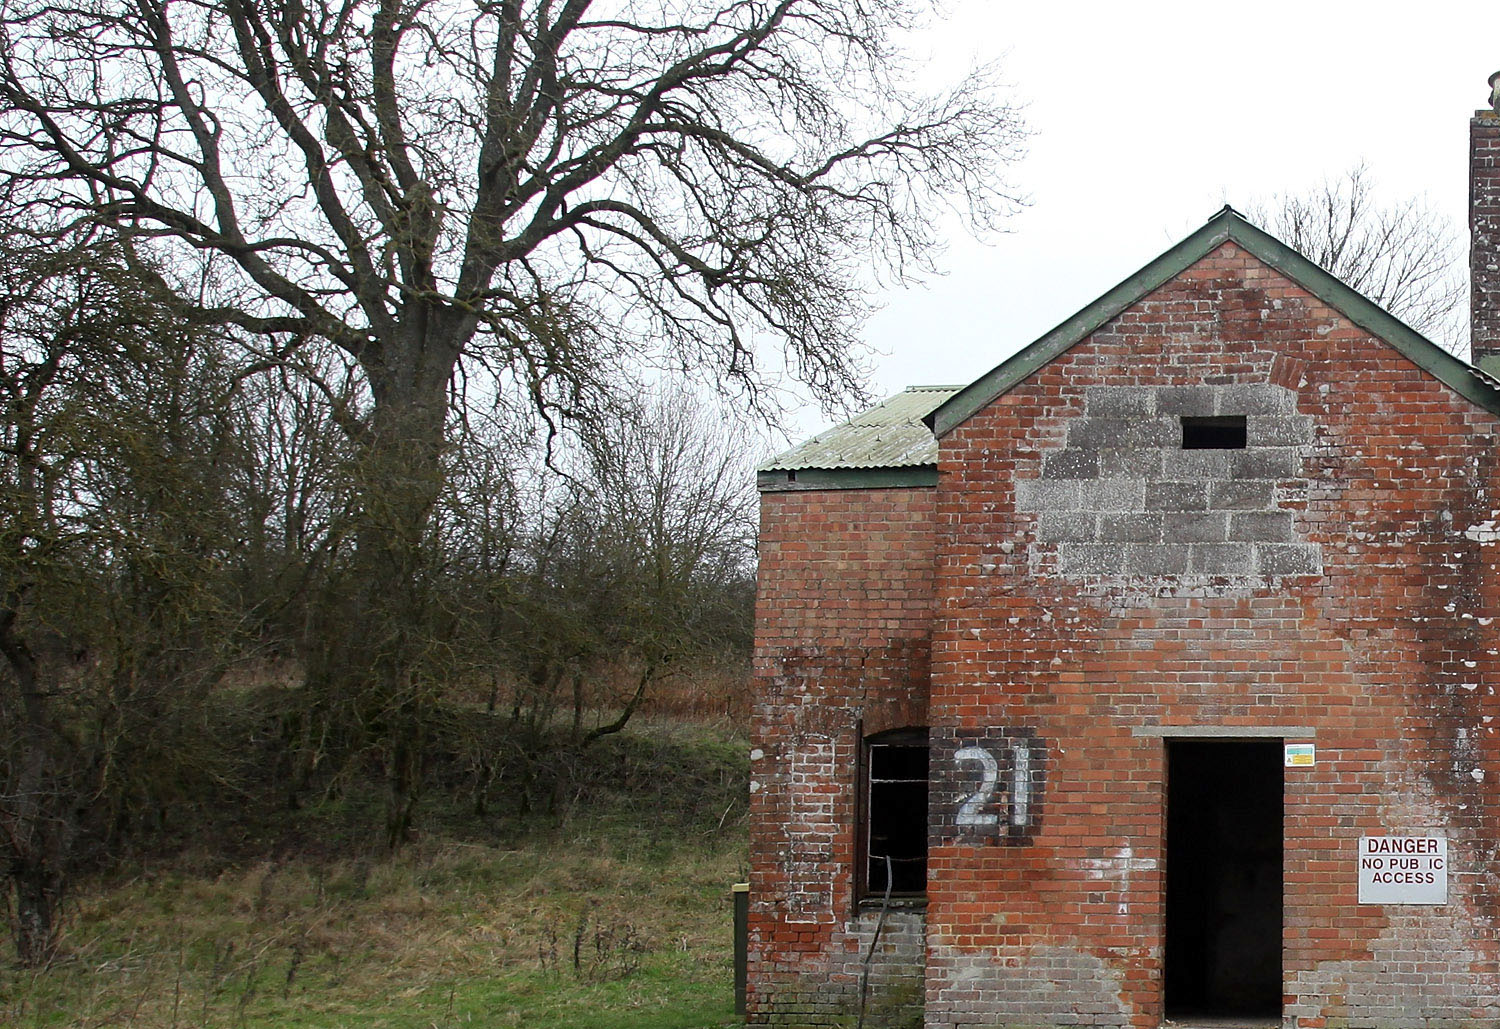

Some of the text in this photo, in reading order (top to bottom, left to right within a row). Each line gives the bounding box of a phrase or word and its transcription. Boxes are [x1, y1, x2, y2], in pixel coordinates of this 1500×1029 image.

[954, 746, 1029, 825] 21
[1368, 838, 1438, 853] DANGER
[1362, 858, 1444, 870] NO PUBIC
[1372, 872, 1434, 884] ACCESS
